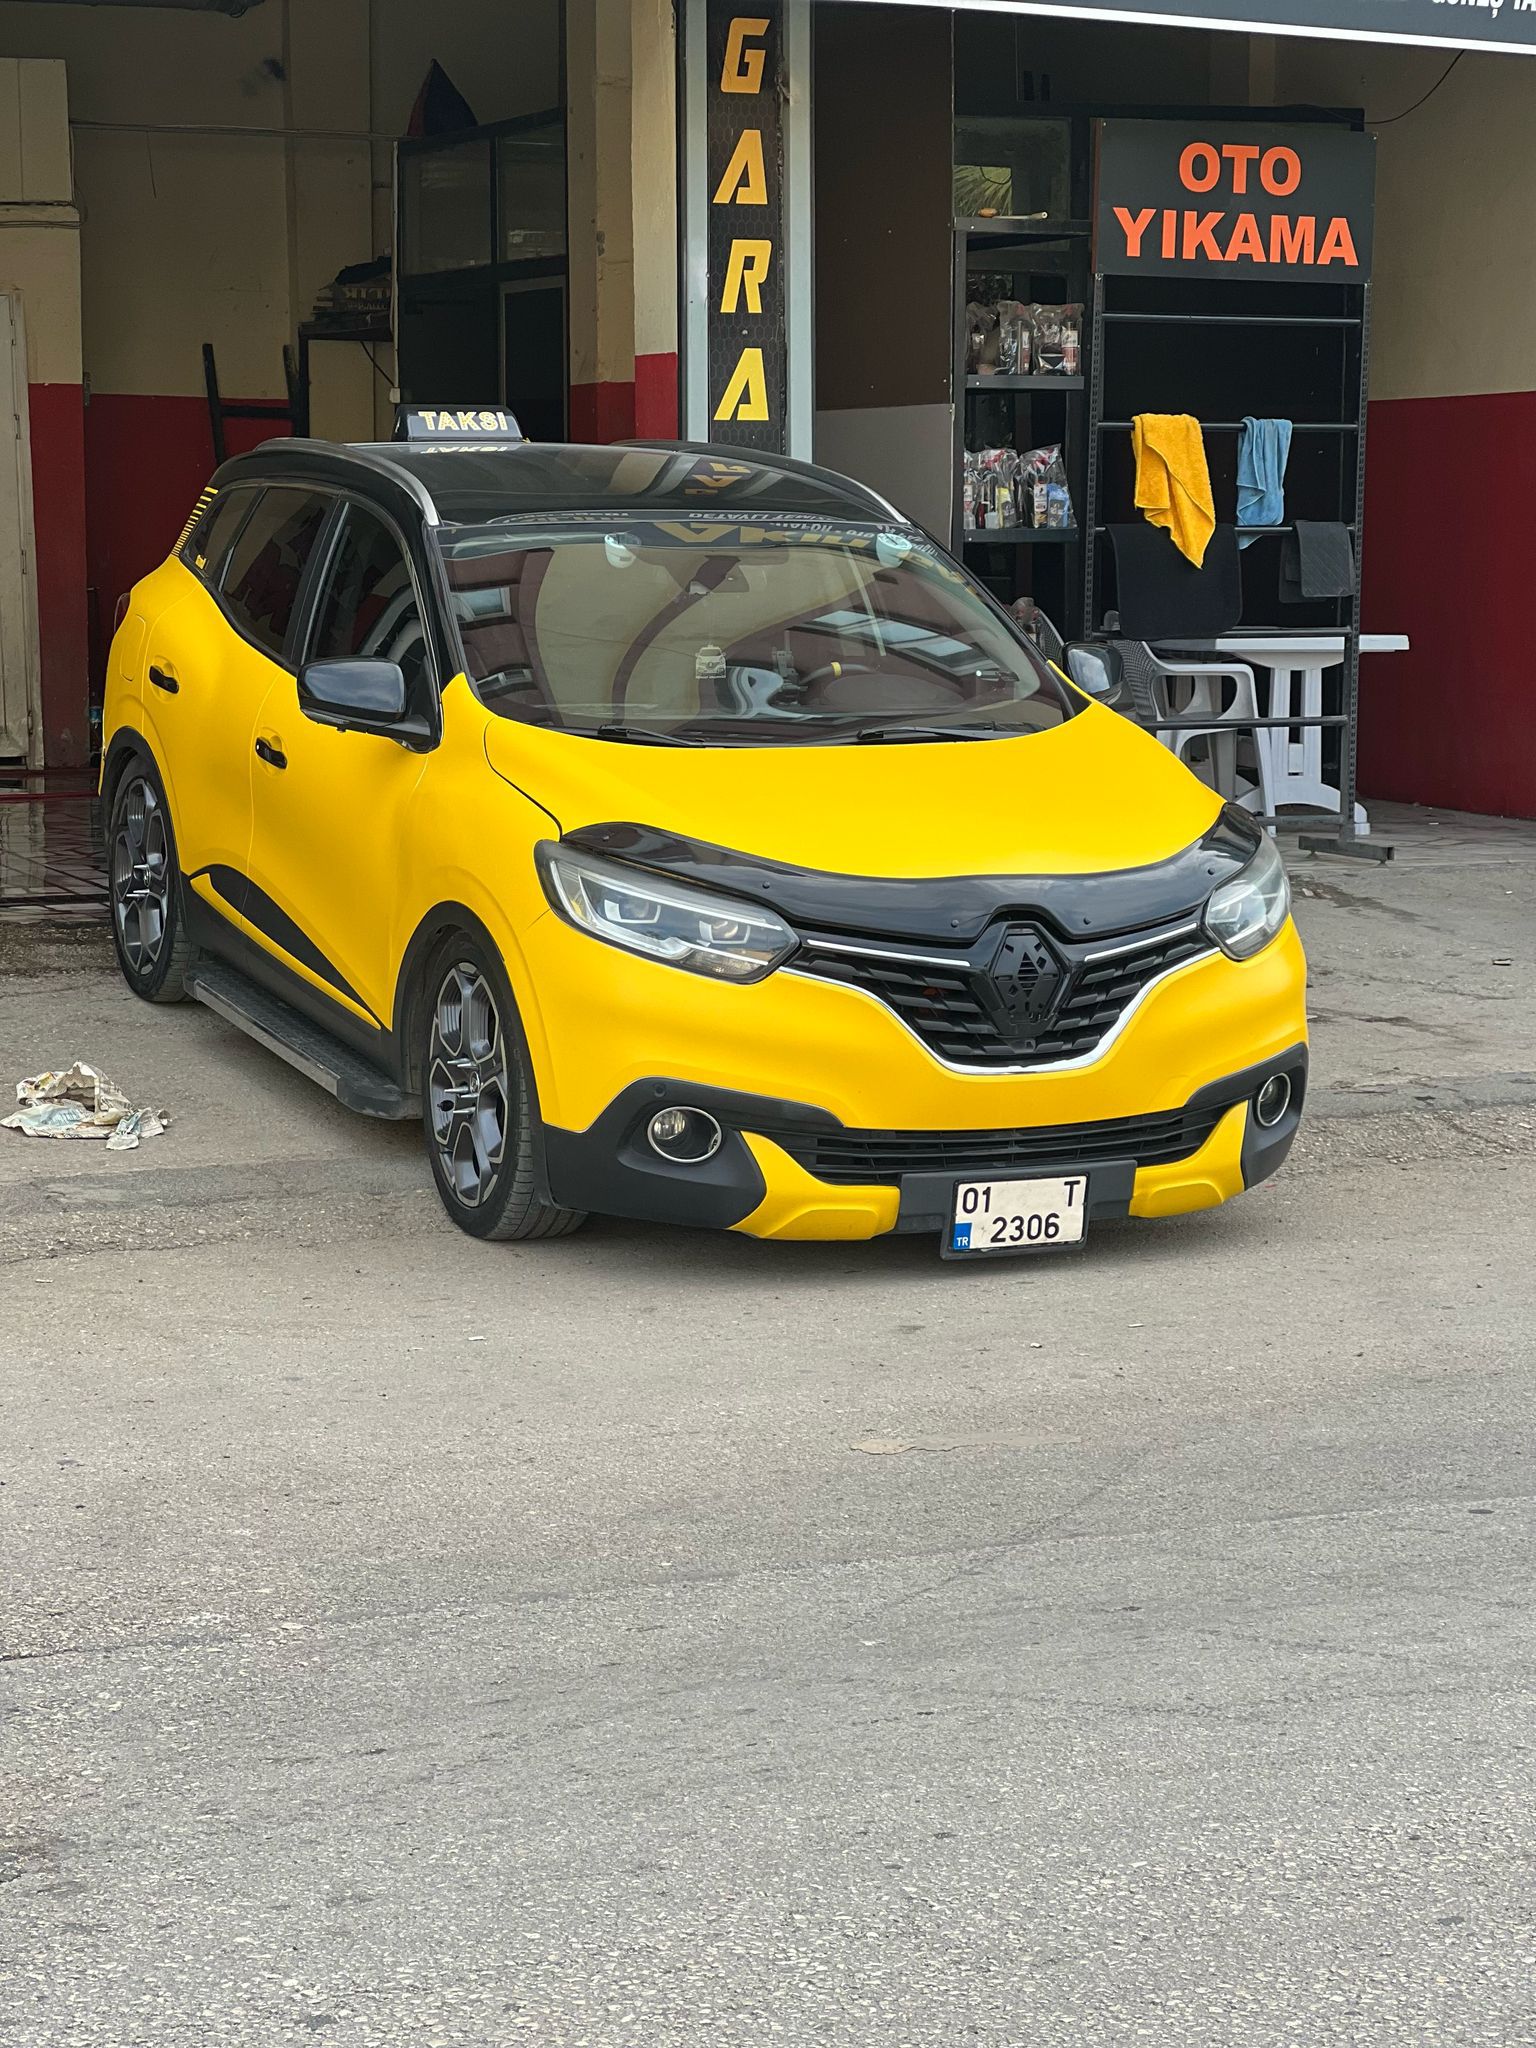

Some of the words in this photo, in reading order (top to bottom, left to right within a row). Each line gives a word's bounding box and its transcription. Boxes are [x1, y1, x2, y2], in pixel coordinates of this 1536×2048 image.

[1179, 142, 1301, 197] OTO
[1112, 207, 1359, 266] YIKAMA
[418, 411, 508, 431] TAKSI
[962, 1186, 991, 1214] 01
[1063, 1180, 1081, 1207] T
[956, 1236, 968, 1246] TR
[990, 1212, 1060, 1243] 2306
